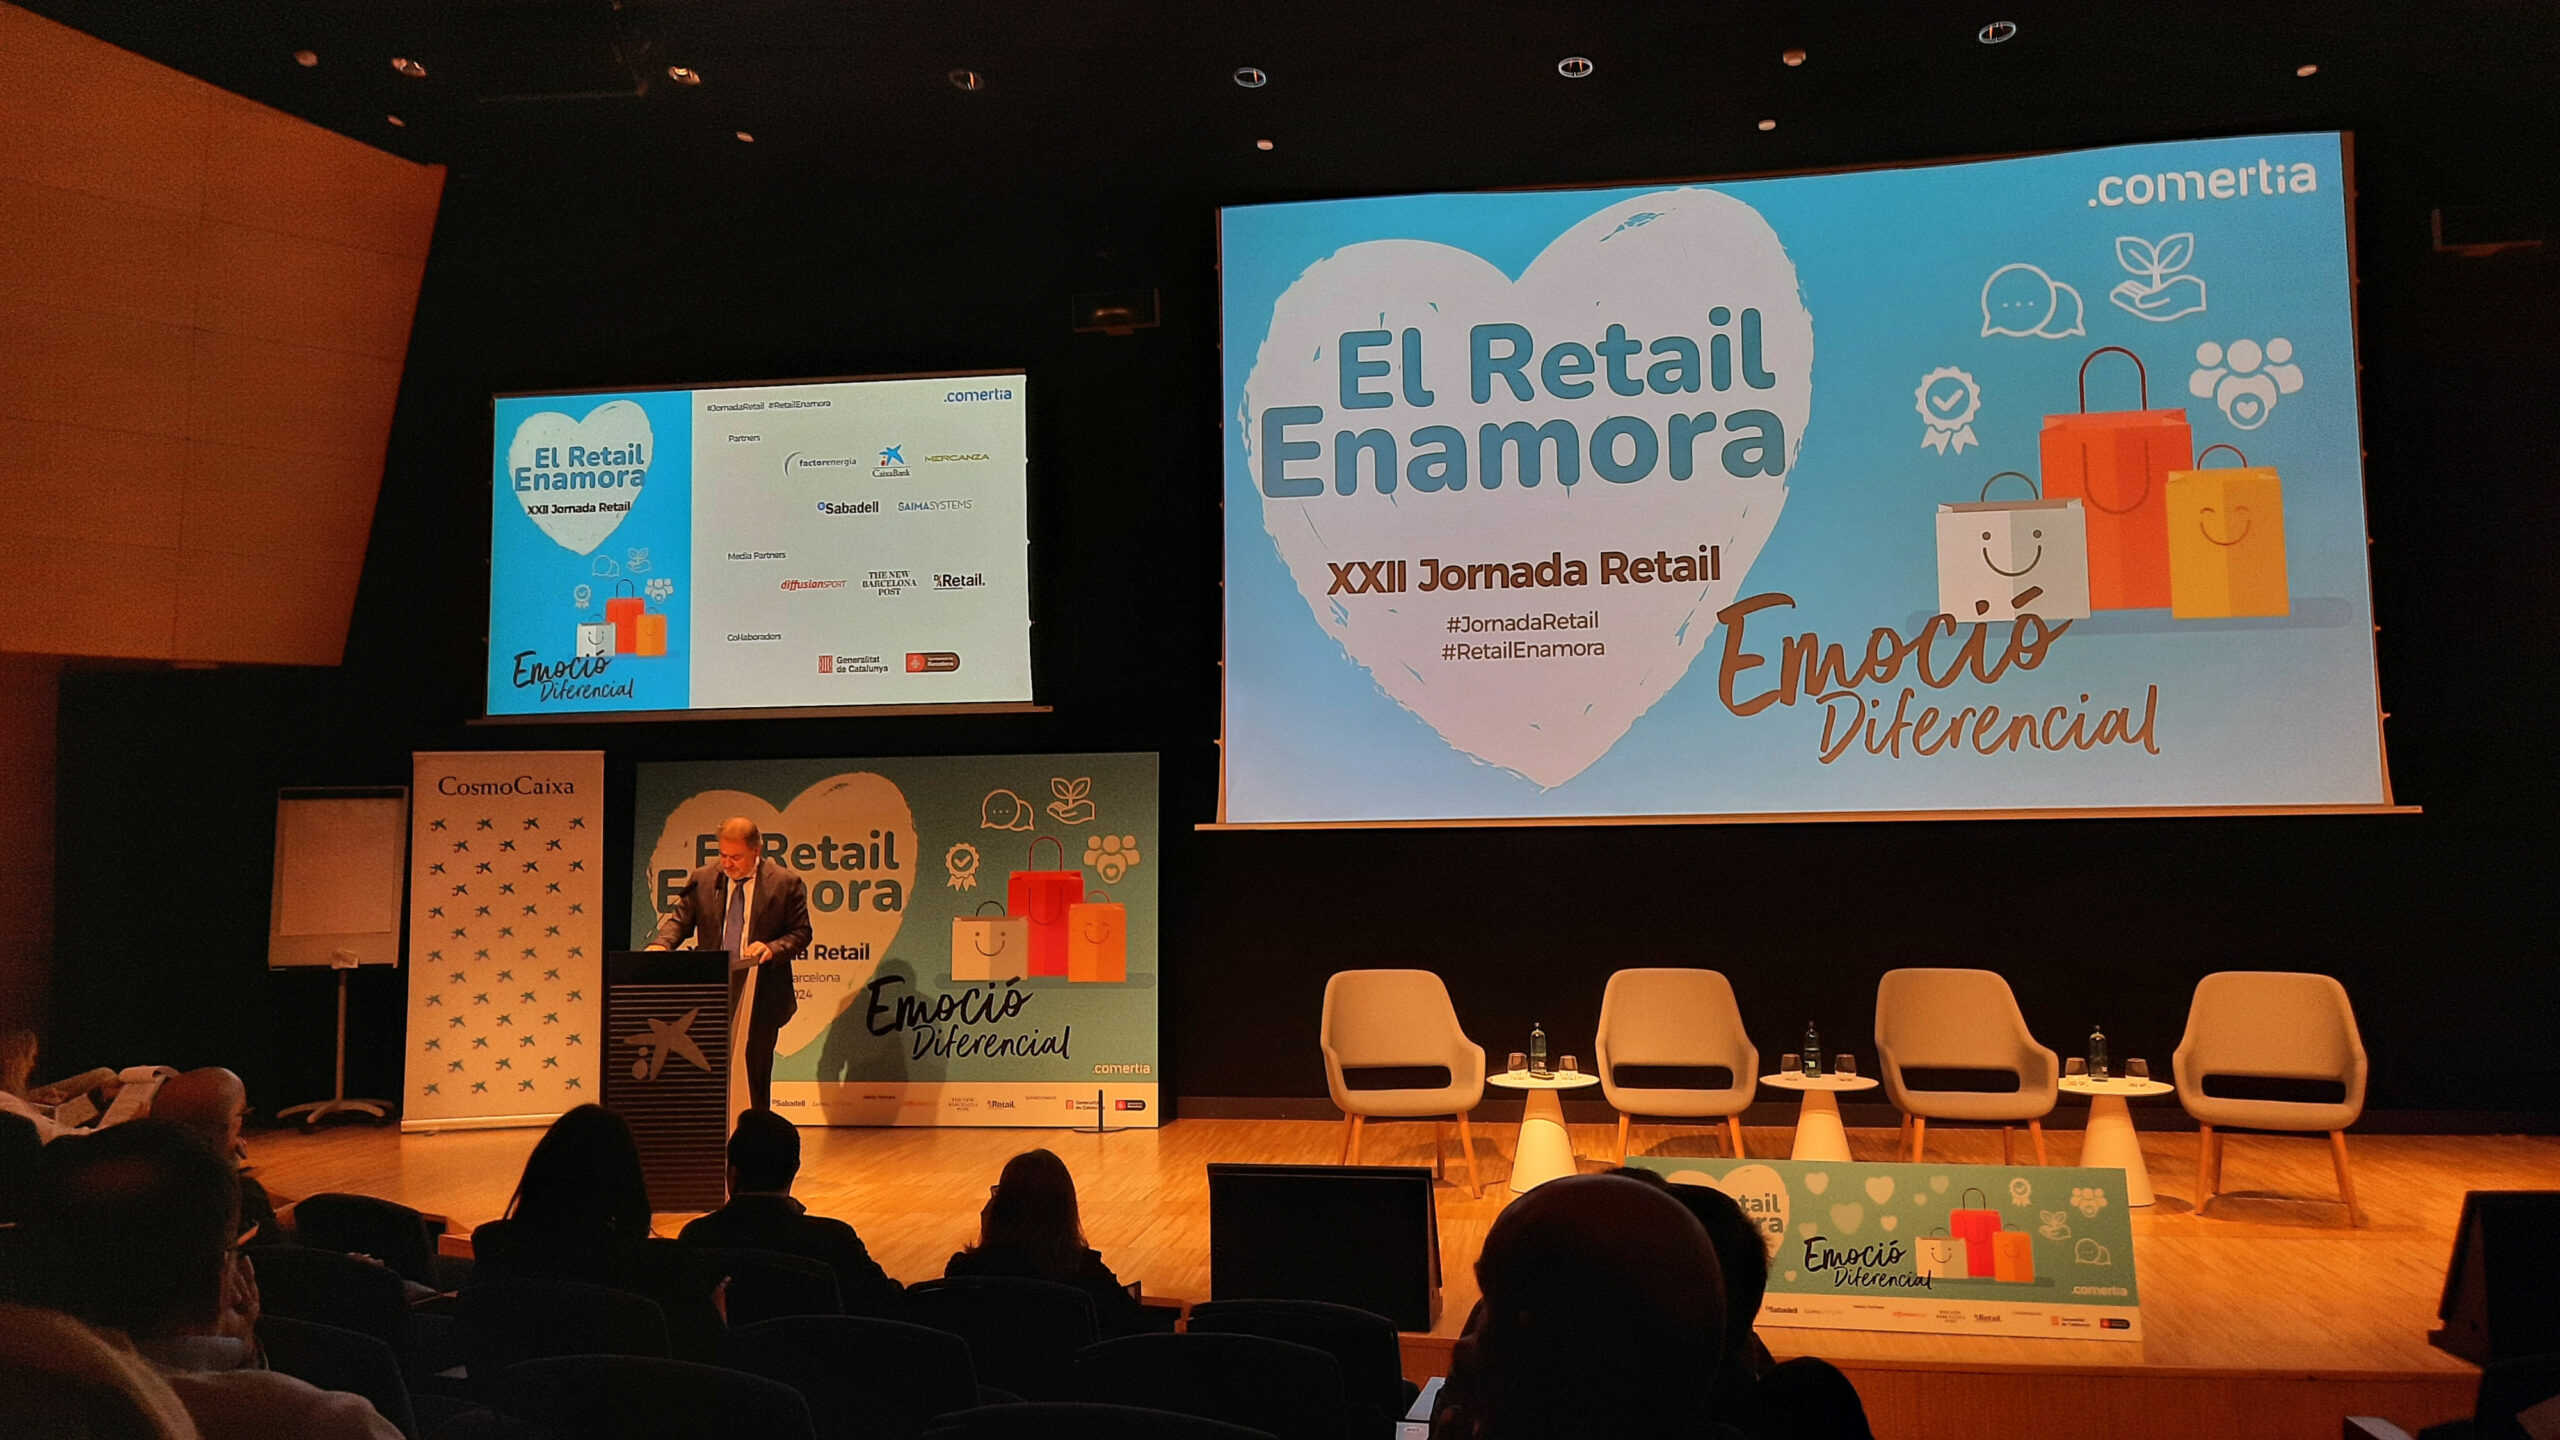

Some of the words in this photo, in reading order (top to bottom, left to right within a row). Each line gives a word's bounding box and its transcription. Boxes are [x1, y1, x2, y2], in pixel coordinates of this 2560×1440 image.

[2087, 158, 2317, 207] .comertia
[1338, 326, 1435, 410] El
[1469, 305, 1777, 405] Retail
[943, 387, 1013, 403] .comertia
[728, 434, 761, 443] Partners
[535, 447, 560, 469] El
[568, 443, 645, 467] Retail
[924, 453, 990, 463] MERCANZA
[1261, 404, 1787, 499] Enamora
[799, 457, 857, 468] factorenergia
[515, 467, 646, 492] Enamora
[527, 504, 549, 515] XXII
[551, 503, 596, 514] Jornada
[599, 501, 631, 513] Retail
[825, 501, 879, 514] Sabadell
[727, 552, 752, 560] Media
[753, 551, 787, 559] Partners
[868, 571, 887, 579] THE
[888, 570, 910, 579] NEW
[1326, 559, 1407, 596] XXII
[1417, 551, 1588, 593] Jornada
[1600, 544, 1721, 585] Retail
[862, 578, 917, 588] BARCELONA
[878, 588, 902, 596] POST
[1446, 610, 1600, 634] #JornadaRetail
[836, 656, 880, 664] Generalitat
[1441, 640, 1606, 662] #RetailEnamora
[1716, 585, 2074, 717] Emoció
[513, 649, 612, 688] Emoció
[836, 665, 847, 673] de
[848, 664, 889, 674] Catalunya
[540, 677, 634, 702] Diferencial
[1815, 683, 2161, 765] Diferencial
[438, 775, 575, 796] CosmoCaixa
[814, 942, 870, 961] Retail
[793, 972, 841, 983] arcelona
[866, 975, 1034, 1037] Emoció
[912, 1023, 1071, 1061] Diferencial
[1091, 1063, 1151, 1074] .comertia
[1804, 1236, 1907, 1272] Emoció
[1834, 1266, 1932, 1290] Diferencial
